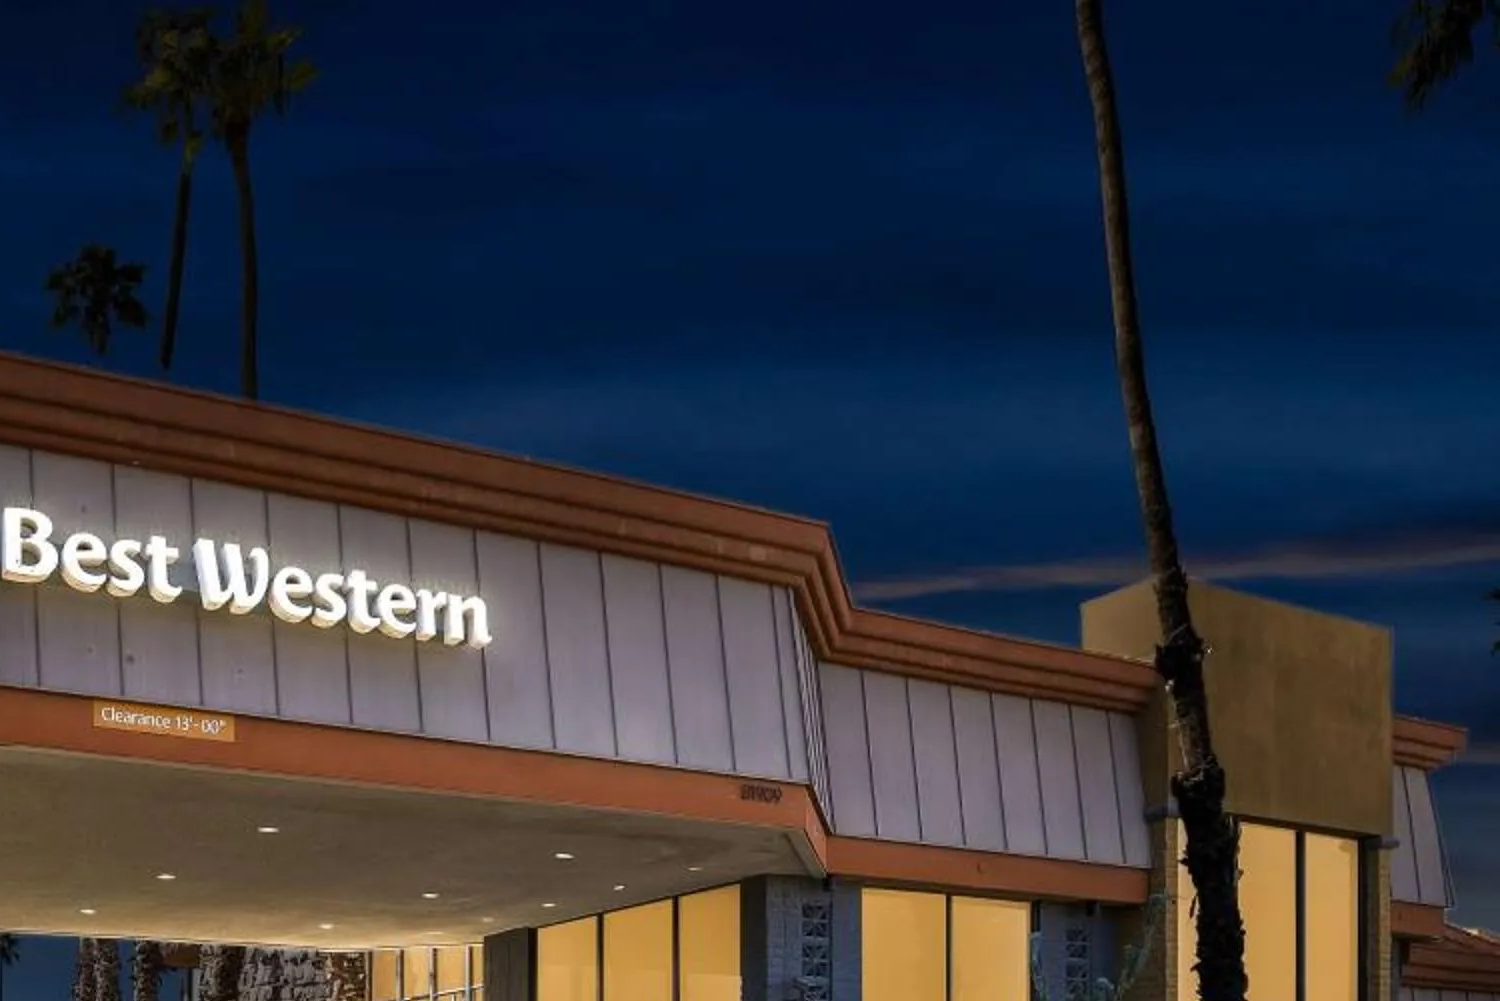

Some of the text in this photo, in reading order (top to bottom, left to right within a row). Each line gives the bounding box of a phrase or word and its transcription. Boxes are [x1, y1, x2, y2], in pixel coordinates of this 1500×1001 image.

[2, 507, 493, 648] Best Western
[101, 706, 172, 729] Clearance
